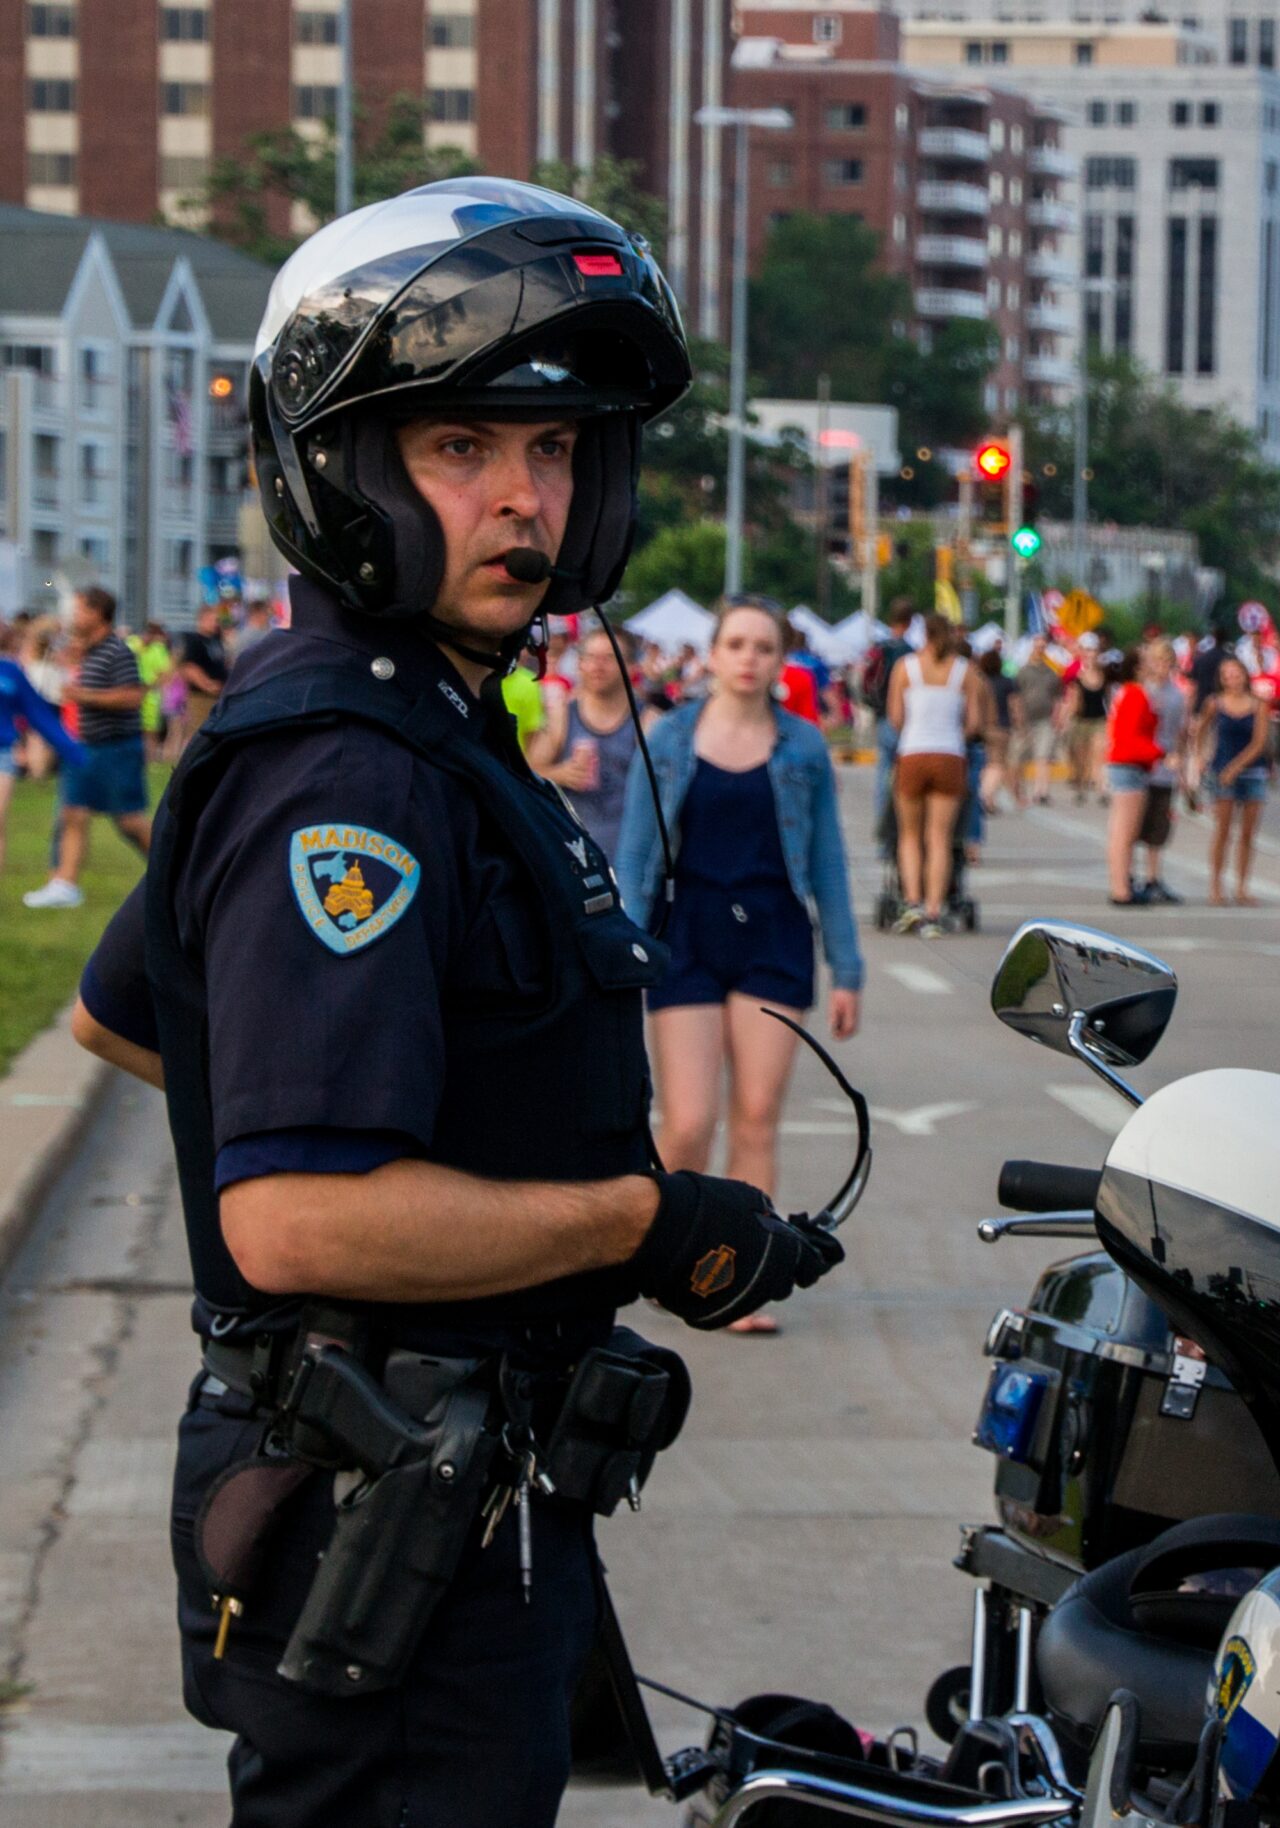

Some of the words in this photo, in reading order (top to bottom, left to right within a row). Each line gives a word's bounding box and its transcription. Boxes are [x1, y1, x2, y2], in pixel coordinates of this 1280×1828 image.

[299, 828, 417, 876] MADISON
[295, 864, 326, 930] POLICE
[343, 888, 412, 950] DEPARTMENT
